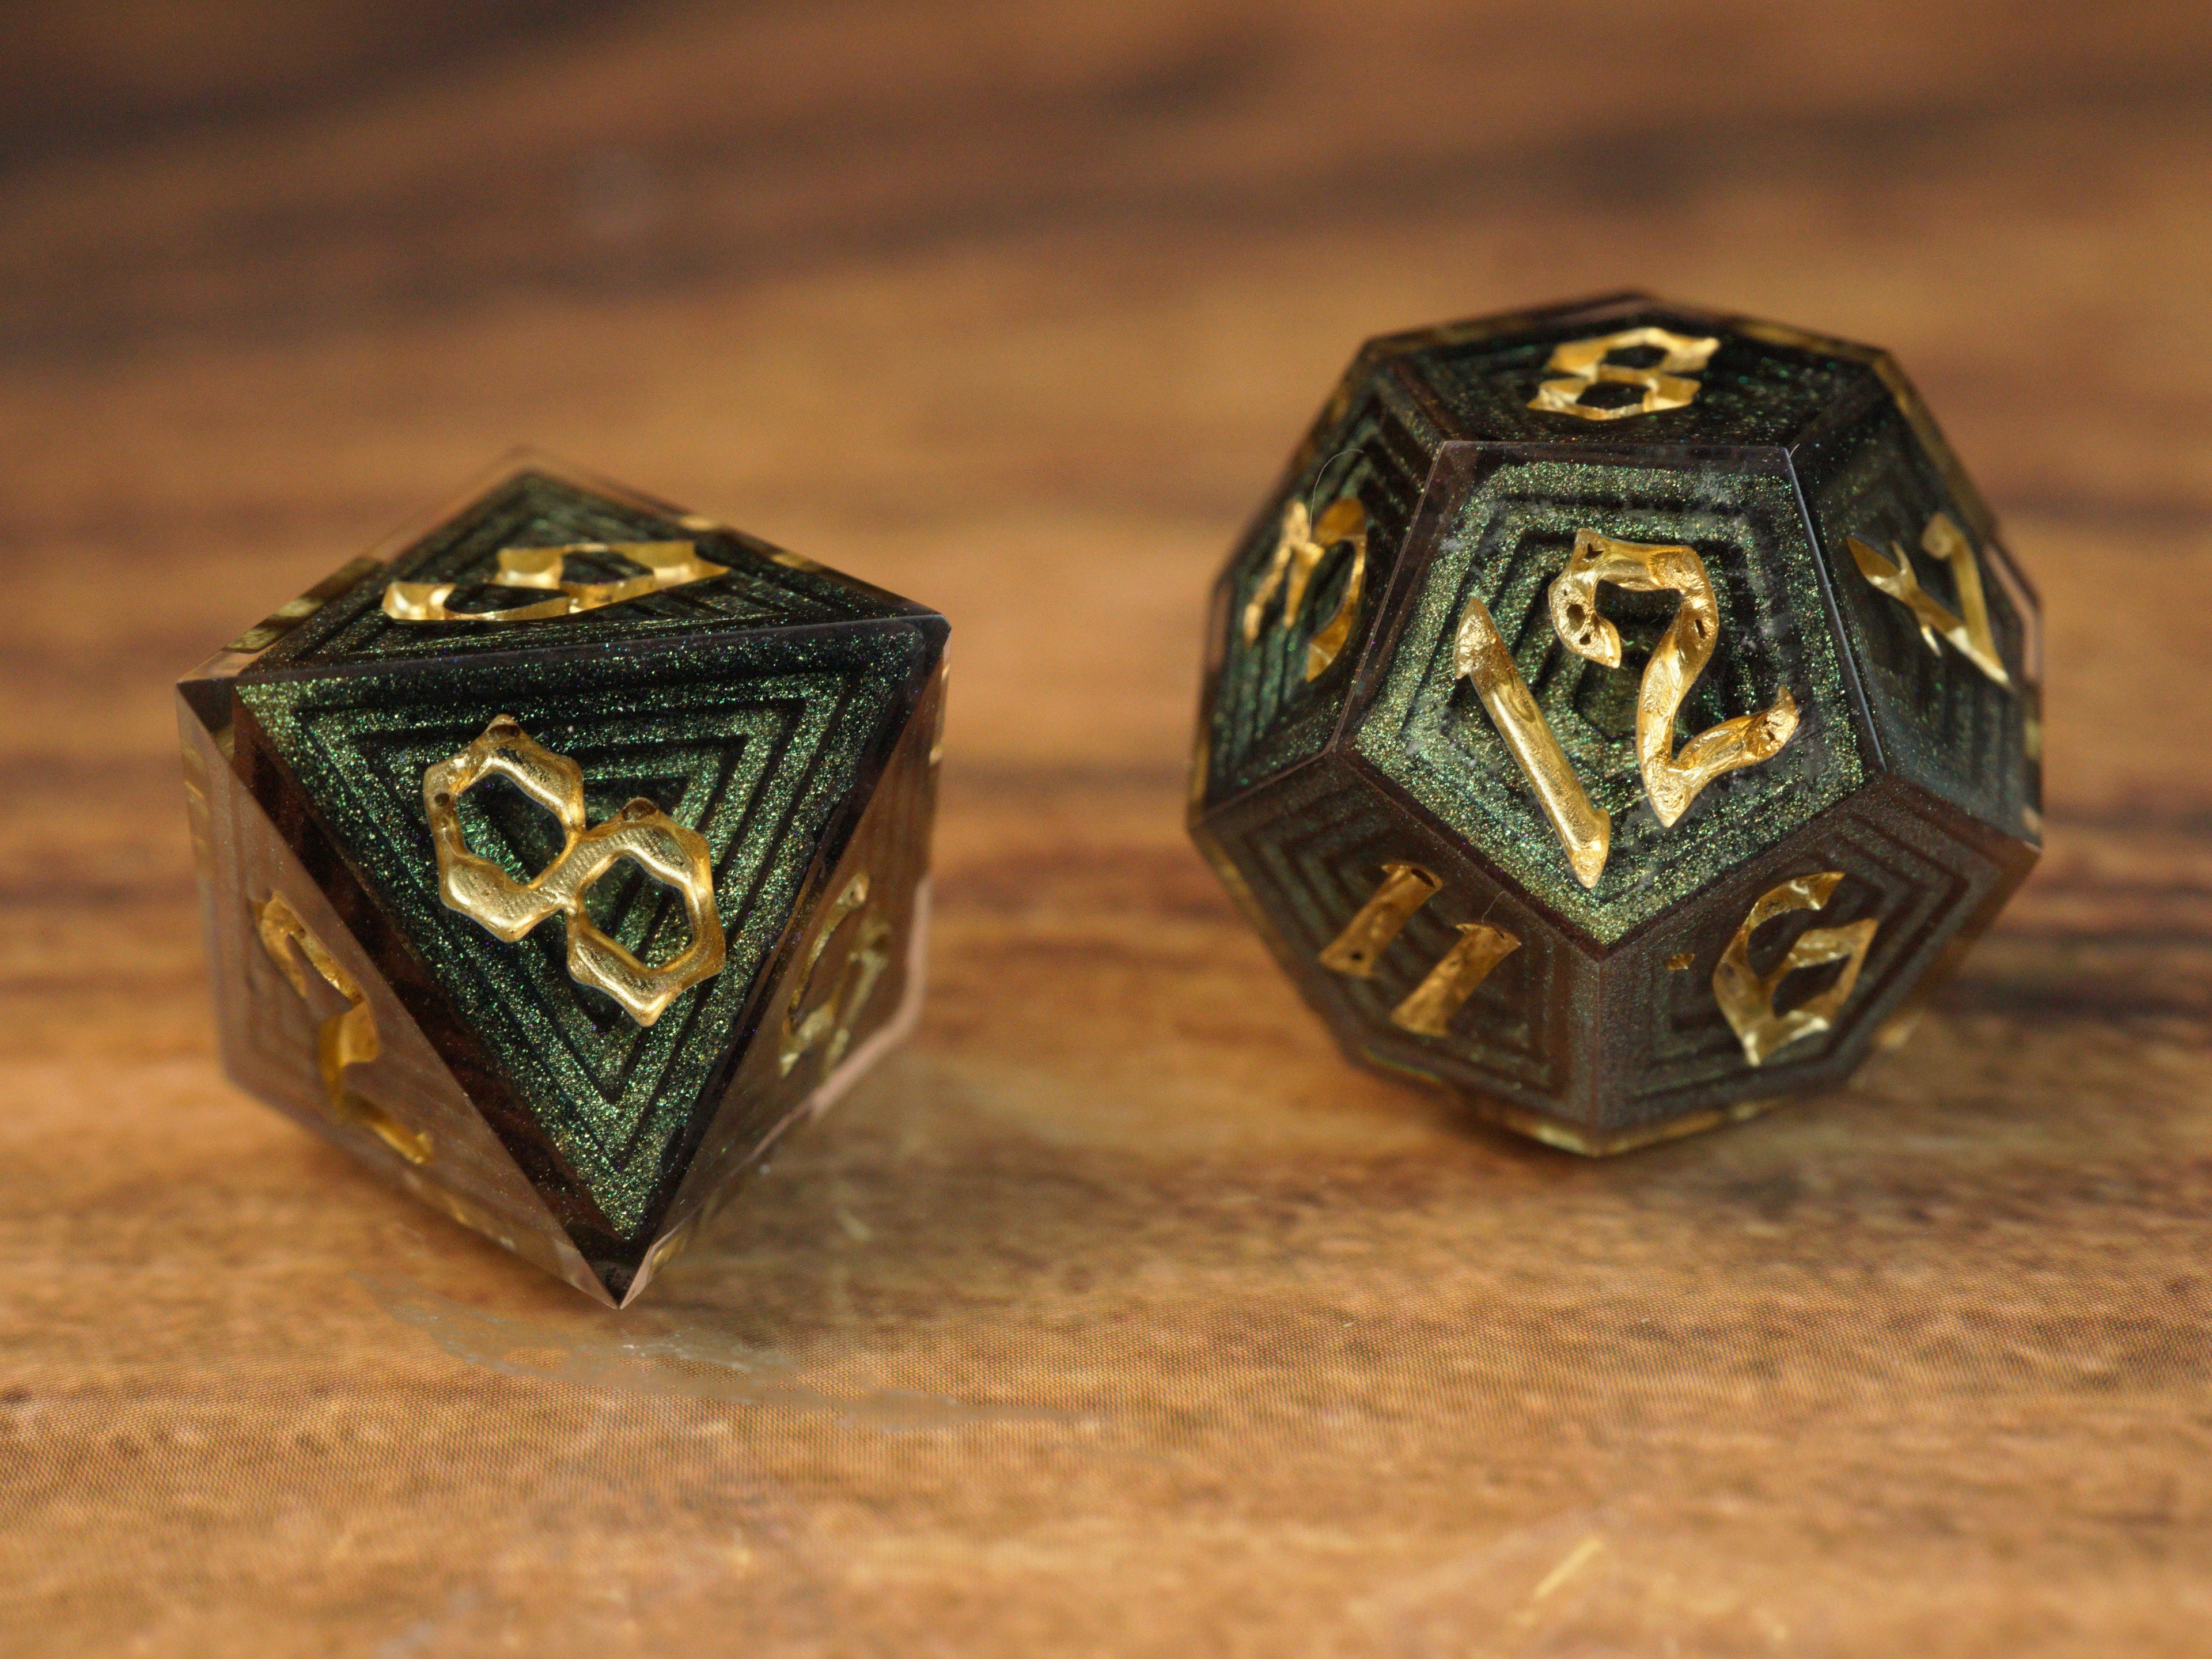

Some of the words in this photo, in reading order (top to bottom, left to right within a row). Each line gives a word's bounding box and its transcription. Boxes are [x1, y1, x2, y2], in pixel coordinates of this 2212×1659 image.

[1527, 327, 1720, 421] 8
[1454, 527, 1800, 889] 12
[422, 714, 727, 1027] 8
[1319, 858, 1522, 1037] 11
